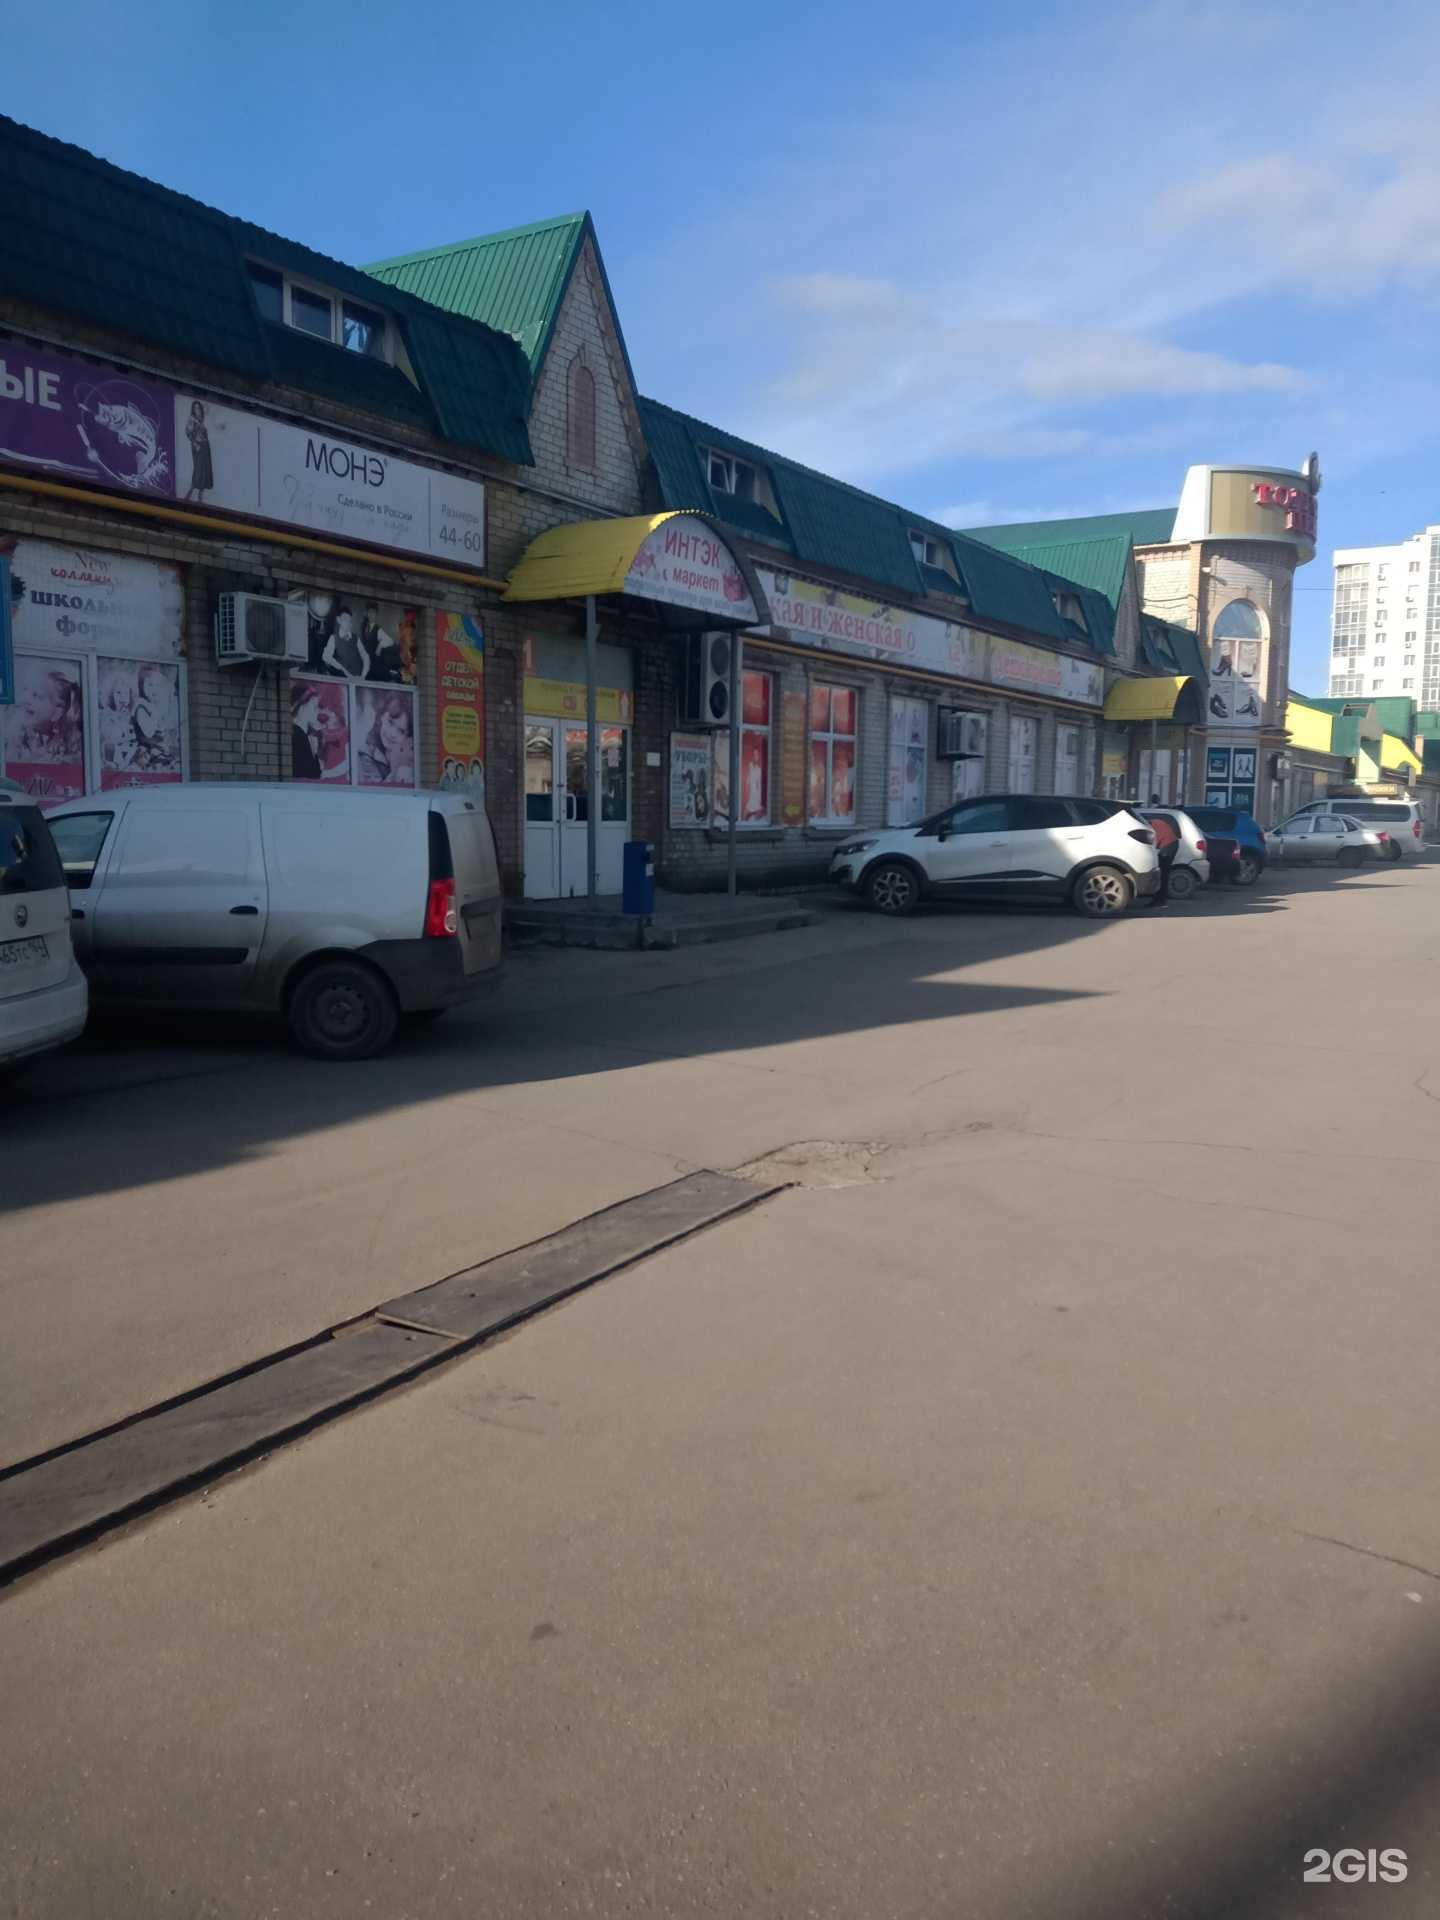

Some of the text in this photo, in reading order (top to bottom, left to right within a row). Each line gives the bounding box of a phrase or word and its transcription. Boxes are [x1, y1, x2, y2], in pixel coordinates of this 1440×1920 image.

[305, 438, 385, 487] МОНЭ
[337, 493, 413, 521] Сделано в России
[439, 525, 481, 553] 44-60
[664, 528, 721, 568] ИНТЭК
[672, 568, 721, 593] маркет
[828, 611, 902, 648] женская
